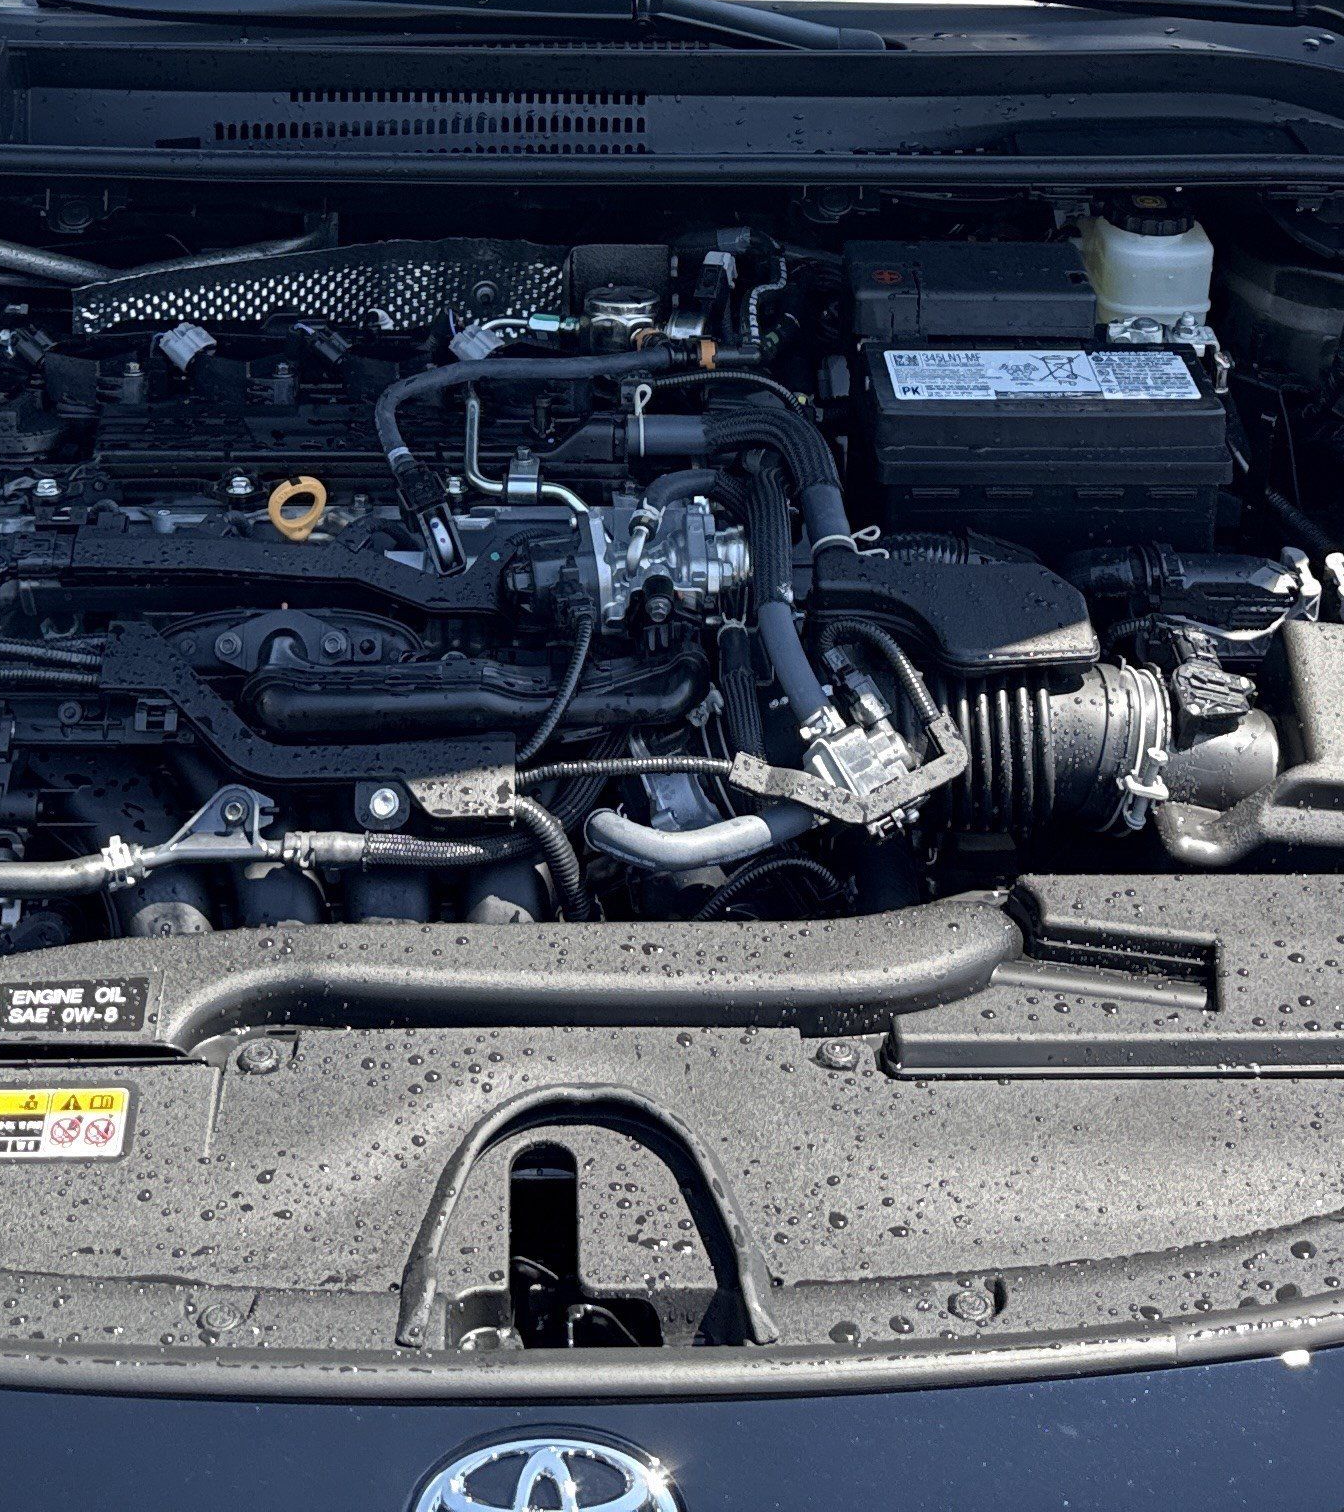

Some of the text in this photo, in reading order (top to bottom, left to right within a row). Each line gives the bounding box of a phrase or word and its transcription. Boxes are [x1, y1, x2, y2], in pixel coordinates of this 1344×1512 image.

[902, 386, 921, 396] PK
[12, 986, 127, 1005] ENGINE OIL
[8, 1006, 119, 1024] SAE 0W-8
